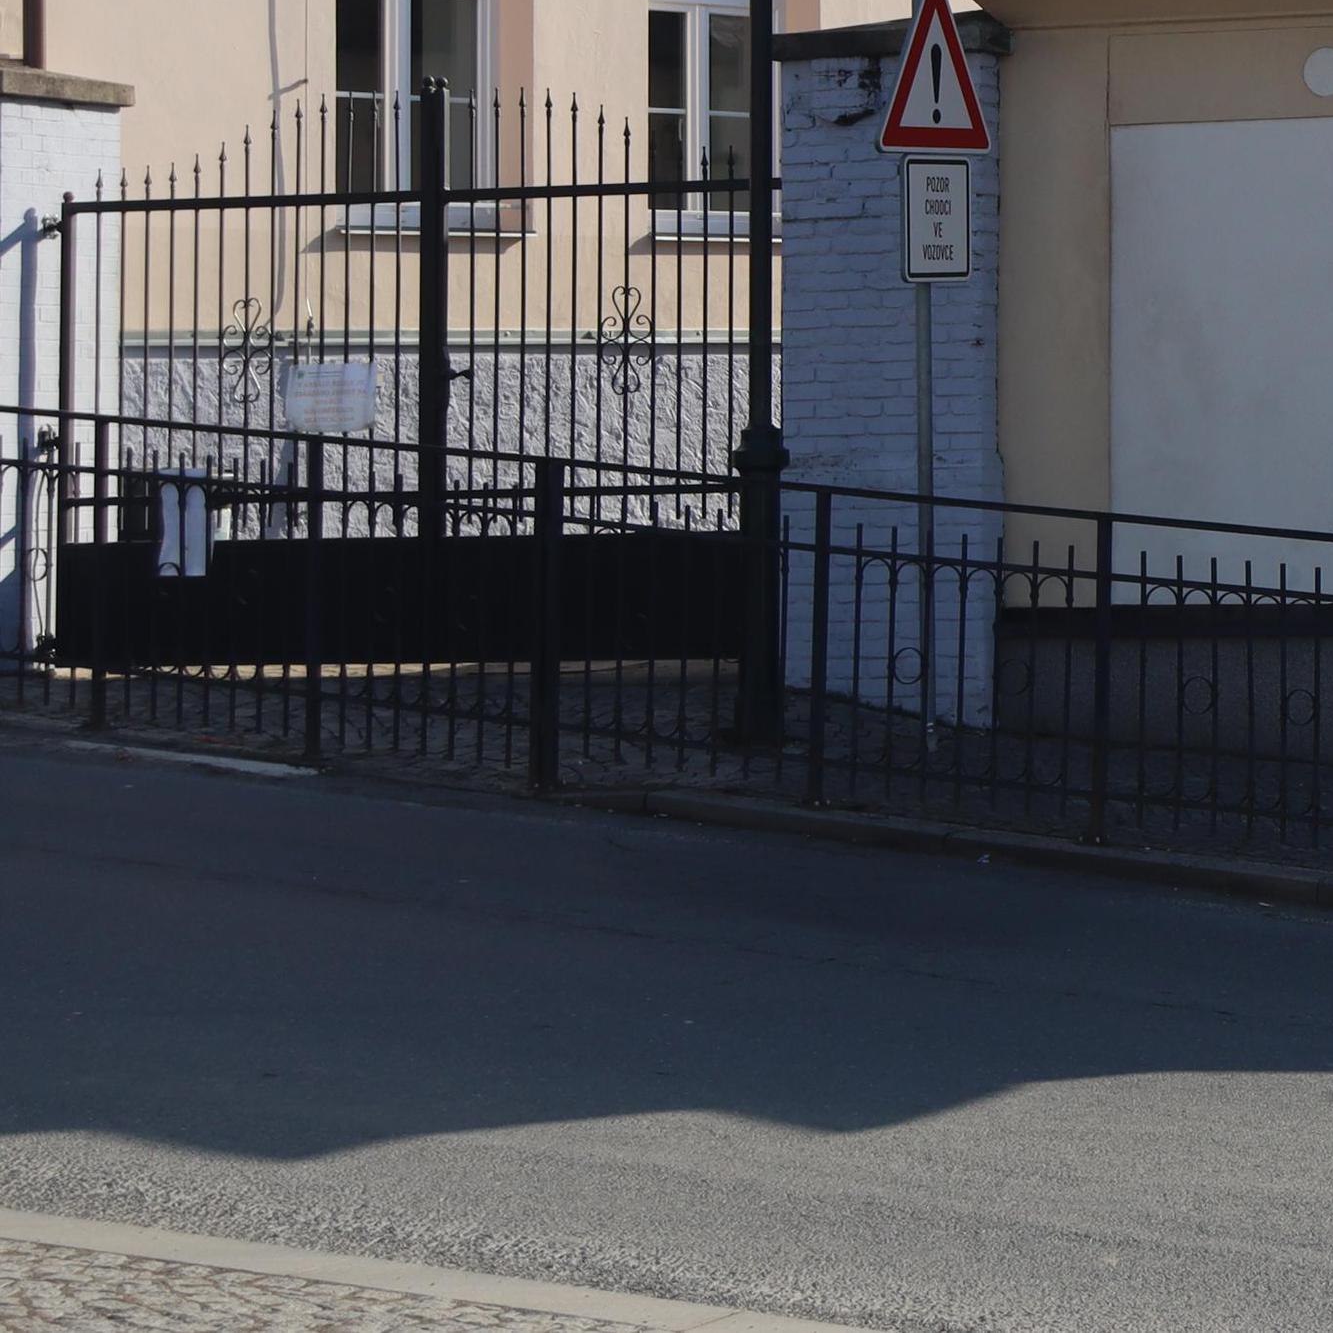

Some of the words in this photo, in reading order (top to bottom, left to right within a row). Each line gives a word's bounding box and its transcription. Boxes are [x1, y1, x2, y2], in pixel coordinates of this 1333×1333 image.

[926, 176, 950, 193] POZOR
[925, 199, 952, 215] CHODCI
[933, 222, 942, 238] VE
[922, 244, 954, 261] VOZOVCE
